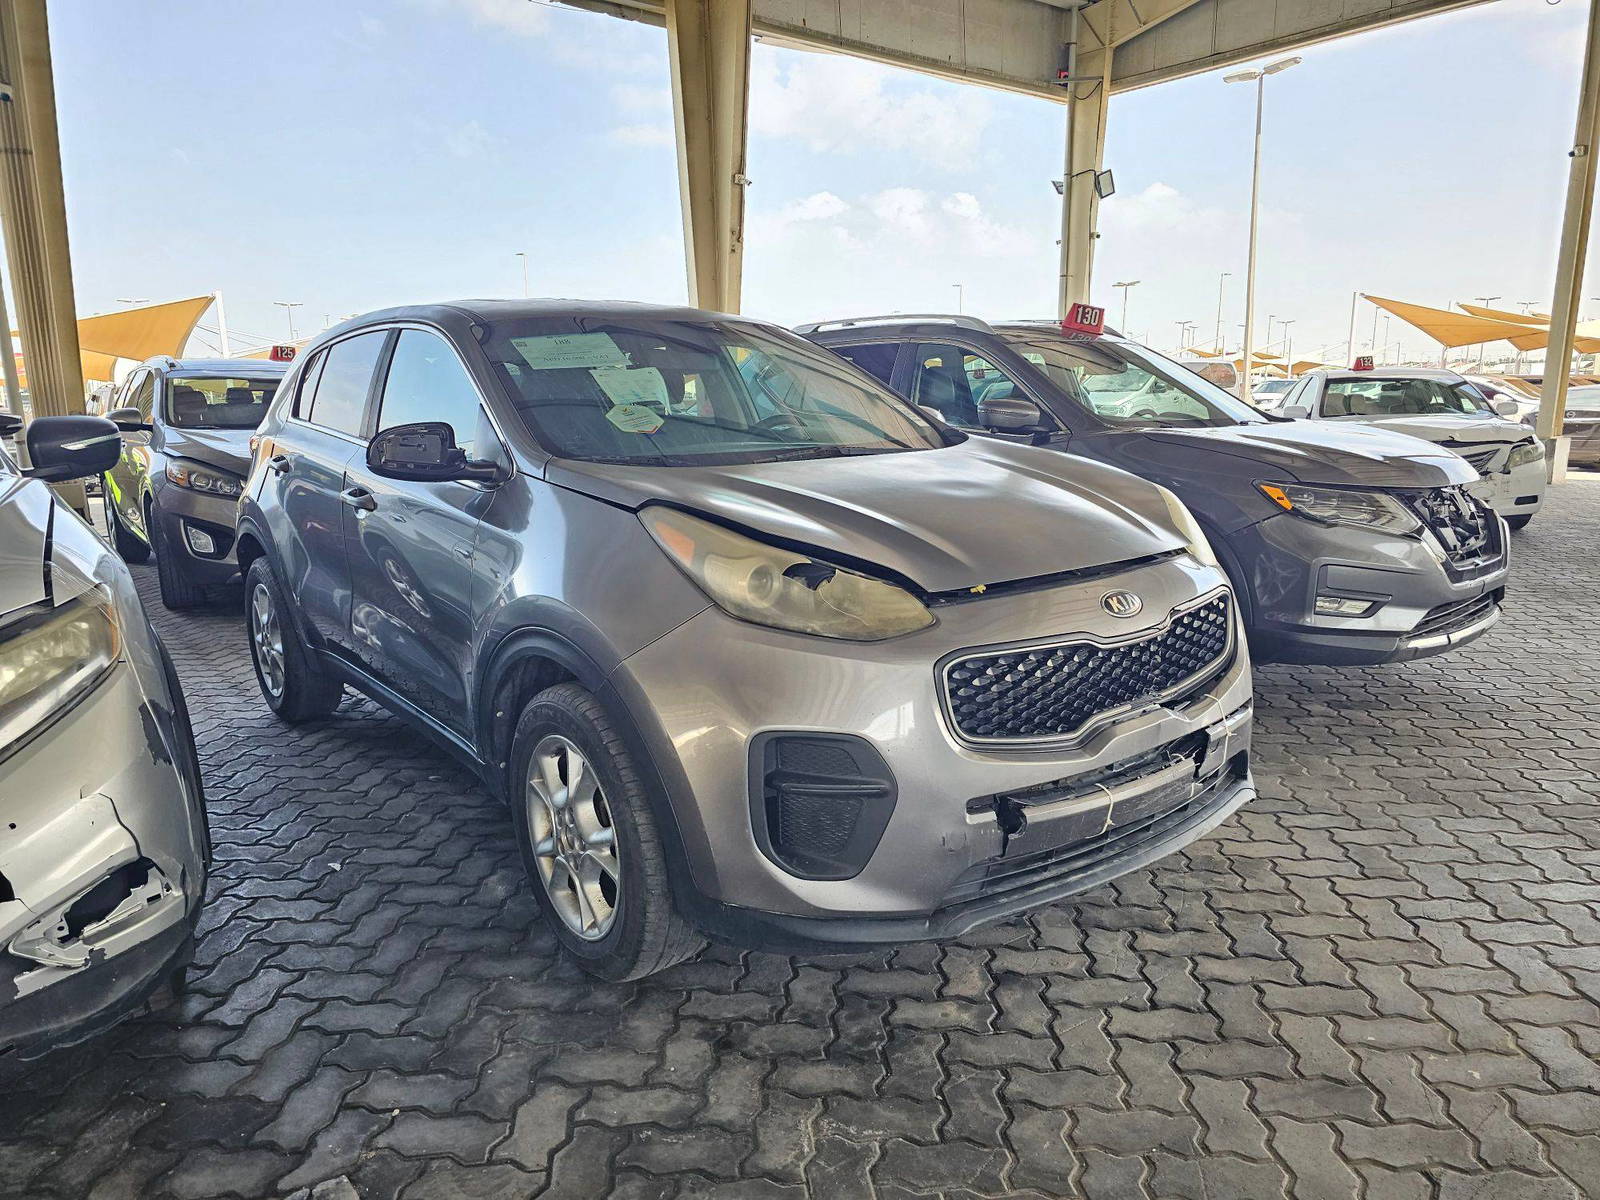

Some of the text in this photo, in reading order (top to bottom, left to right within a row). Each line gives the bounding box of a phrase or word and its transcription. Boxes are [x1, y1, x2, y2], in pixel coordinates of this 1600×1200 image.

[1076, 306, 1100, 325] 130
[277, 347, 293, 359] 125
[1360, 357, 1372, 367] 132
[1105, 592, 1141, 614] KIA
